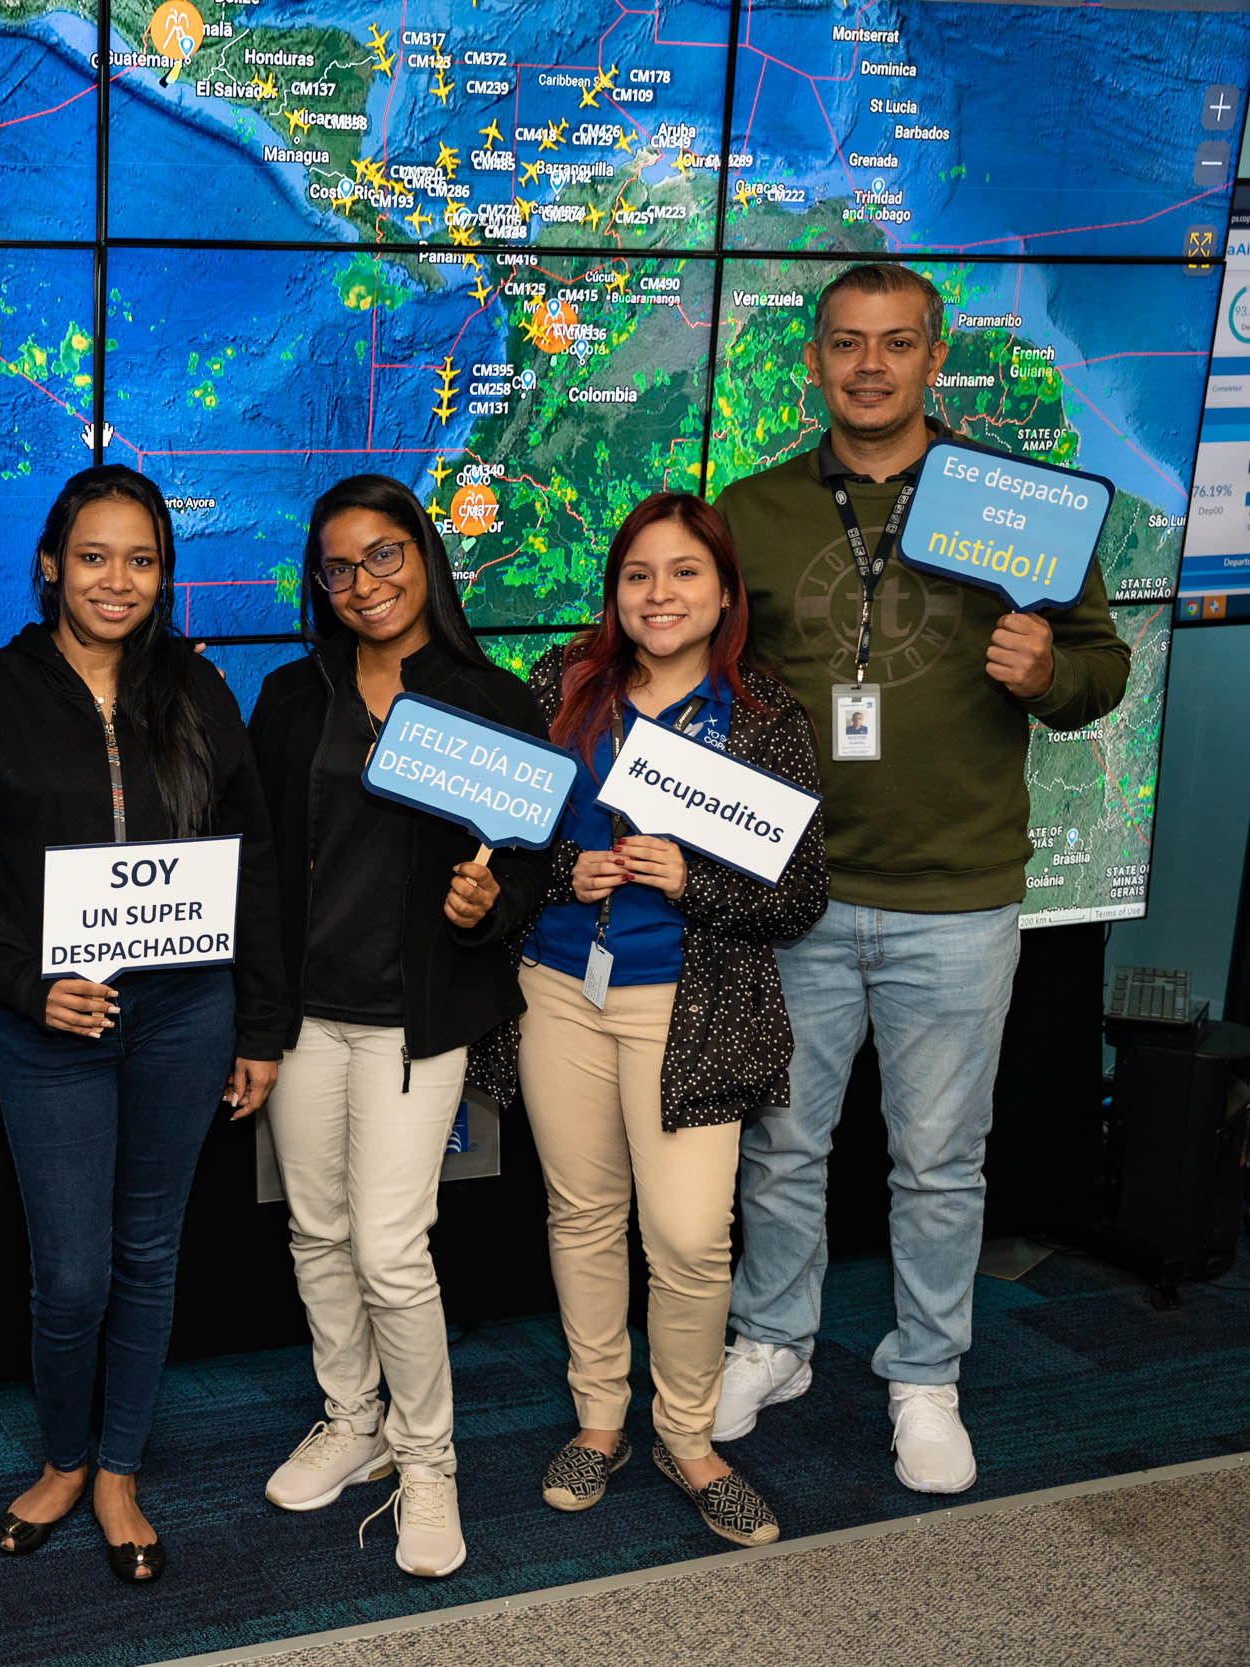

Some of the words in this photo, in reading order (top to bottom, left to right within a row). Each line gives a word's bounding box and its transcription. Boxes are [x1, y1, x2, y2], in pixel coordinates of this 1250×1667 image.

[402, 32, 446, 46] CM317
[832, 26, 899, 43] Montserrat
[244, 50, 315, 67] Honduras
[464, 52, 507, 66] CM372
[861, 60, 917, 77] Dominica
[538, 74, 591, 88] Caribbean
[630, 69, 671, 83] CM178
[197, 82, 210, 96] El
[291, 83, 336, 96] CM137
[466, 81, 509, 95] CM239
[612, 88, 653, 102] CM109
[870, 99, 883, 113] St
[885, 99, 918, 114] Lucia
[658, 123, 696, 139] Aruba
[894, 125, 950, 140] Barbados
[651, 135, 691, 149] CM349
[264, 147, 330, 164] Managua
[848, 153, 898, 168] Grenada
[536, 161, 614, 178] Barranquilla
[310, 185, 350, 199] Cost
[427, 185, 470, 198] CM286
[767, 190, 805, 202] CM222
[370, 196, 414, 208] CM193
[647, 206, 686, 218] CM223
[842, 207, 864, 220] and
[868, 208, 911, 223] Tobago
[496, 253, 538, 265] CM416
[504, 283, 546, 296] CM125
[640, 278, 680, 290] CM490
[557, 289, 598, 302] CM415
[612, 292, 681, 306] Bucaramanga
[733, 290, 803, 307] Venezuela
[957, 313, 1022, 330] Paramaribo
[1012, 345, 1055, 362] French
[472, 364, 514, 376] CM395
[935, 372, 995, 388] Suriname
[469, 383, 511, 396] CM258
[568, 387, 637, 402] Colombia
[468, 402, 509, 414] CM131
[1017, 429, 1051, 440] STATE
[463, 464, 504, 476] CM340
[943, 456, 980, 483] Ese
[984, 467, 1088, 511] despacho
[1192, 485, 1232, 497] 76.19%
[185, 497, 215, 510] Ayora
[982, 505, 1027, 530] esta
[1148, 515, 1168, 527] São
[928, 531, 1057, 585] nistido!!
[1120, 578, 1152, 589] STATE
[1155, 577, 1168, 588] OF
[1115, 588, 1171, 600] MARANHÃO
[1047, 730, 1103, 743] TOCANTINS
[399, 721, 469, 760] ¡FELIZ
[469, 747, 508, 776] DÍA
[513, 762, 554, 794] DEL
[378, 750, 552, 828] DESPACHADOR!
[628, 757, 784, 843] #ocupaditos
[1050, 826, 1063, 837] OF
[1052, 852, 1090, 866] Brasília
[110, 858, 179, 889] SOY
[1106, 866, 1135, 877] STATE
[1112, 875, 1144, 886] MINAS
[1110, 885, 1145, 898] GERAIS
[82, 907, 118, 928] UN
[125, 901, 203, 925] SUPER
[1095, 909, 1113, 919] Terms
[51, 933, 230, 965] DESPACHADOR
